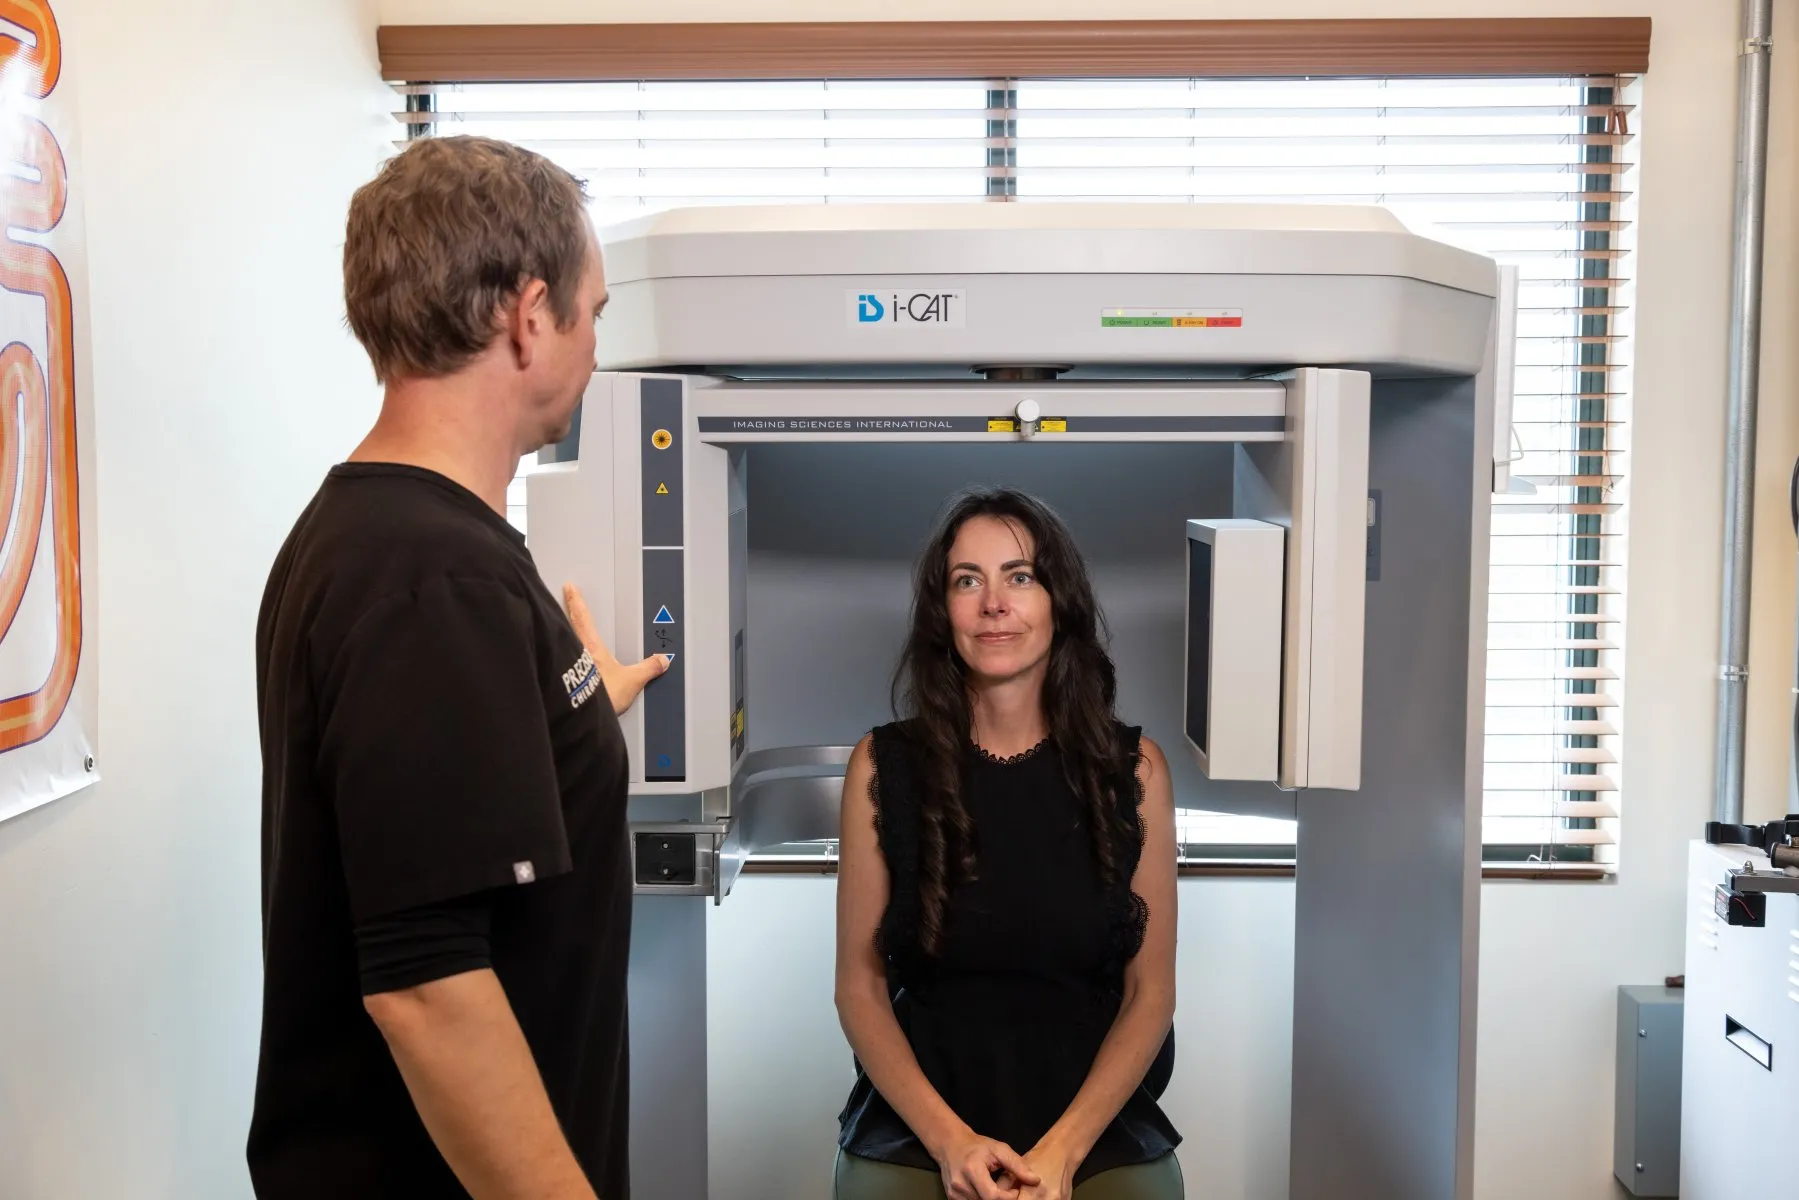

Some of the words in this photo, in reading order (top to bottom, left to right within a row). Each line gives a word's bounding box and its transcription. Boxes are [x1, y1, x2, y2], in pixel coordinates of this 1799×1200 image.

[732, 420, 785, 429] IMAGING
[790, 420, 852, 429] SCIENCES
[856, 420, 953, 429] INTERNATIONAL
